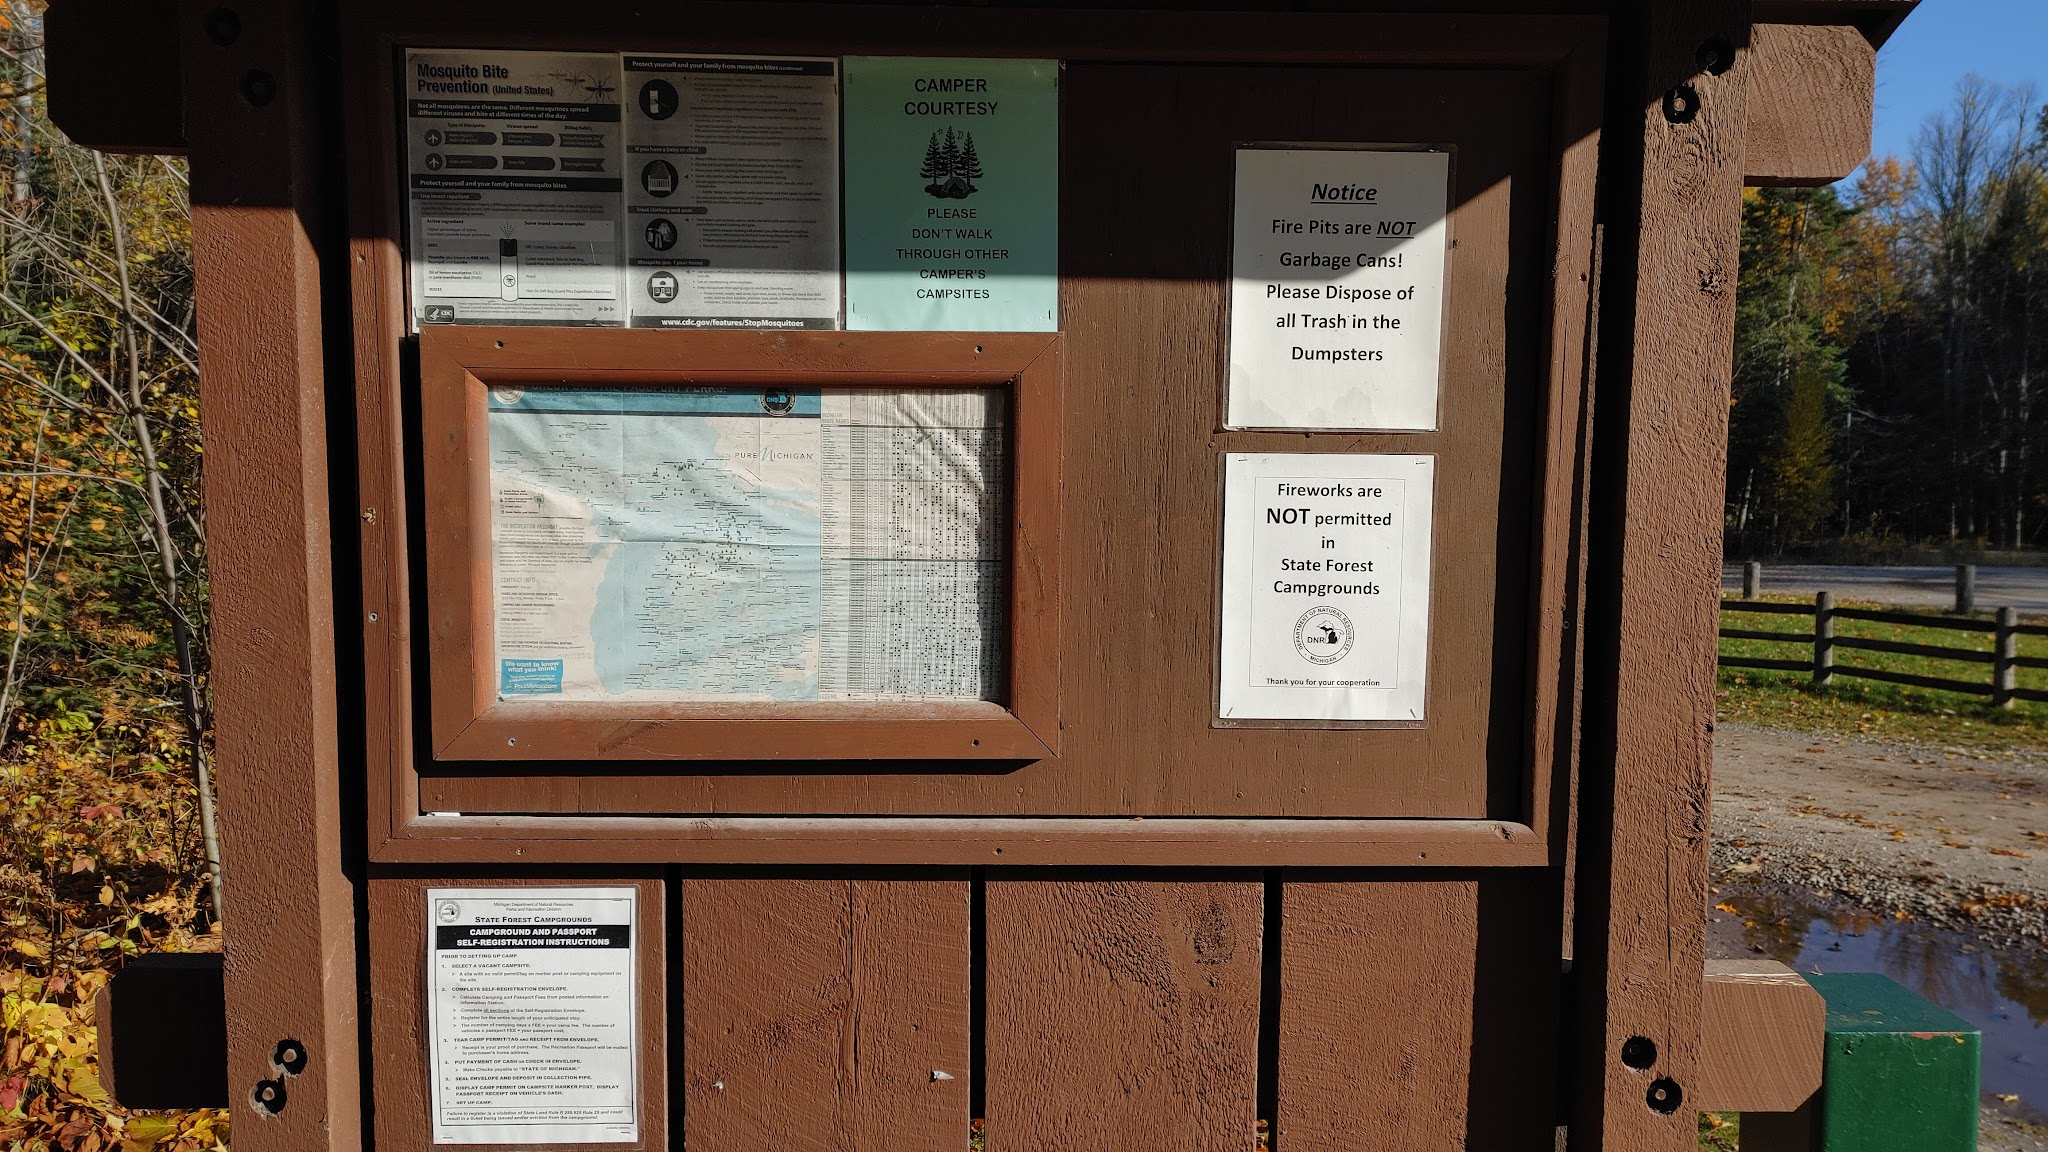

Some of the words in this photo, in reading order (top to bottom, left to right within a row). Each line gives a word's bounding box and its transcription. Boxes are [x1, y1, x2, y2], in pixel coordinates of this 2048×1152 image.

[417, 62, 478, 81] Mosquito
[482, 64, 508, 79] Bite
[417, 78, 488, 94] Prevention
[492, 84, 522, 95] (United
[523, 85, 553, 96] States)
[914, 78, 986, 92] CAMPER
[417, 102, 428, 110] Not
[535, 105, 569, 114] mosquitoes
[904, 101, 998, 115] COURTESY
[1311, 182, 1377, 201] Notice
[927, 208, 976, 218] PLEASE
[912, 228, 952, 239] DON'T
[955, 228, 992, 239] WALK
[1272, 219, 1302, 234] Fire
[1309, 219, 1339, 234] Pits
[1344, 223, 1371, 234] are
[1376, 220, 1416, 235] NOT
[895, 248, 960, 259] THROUGH
[964, 248, 1008, 259] OTHER
[1279, 251, 1350, 270] Garbage
[1356, 252, 1402, 269] Cans!
[919, 268, 986, 279] CAMPER'S
[916, 288, 989, 298] CAMPSITES
[1266, 283, 1320, 299] Please
[1326, 285, 1390, 302] Dispose
[1396, 285, 1414, 300] of
[661, 318, 804, 328] www.cdc.gov/features/StopMosquitoes
[1276, 312, 1295, 328] all
[1301, 313, 1346, 328] Trash
[1352, 314, 1366, 328] in
[1373, 314, 1400, 329] the
[1292, 346, 1382, 364] Dumpsters
[756, 446, 812, 462] MICHIGAN
[1278, 482, 1352, 497] Fireworks
[1357, 487, 1381, 497] are
[1267, 507, 1310, 524] NOT
[1315, 511, 1391, 527] permitted
[1321, 536, 1334, 548] in
[1281, 558, 1320, 571] State
[1326, 559, 1373, 572] Forest
[1273, 580, 1379, 597] Campgrounds
[1295, 614, 1309, 651] DEPARTMENT
[1317, 607, 1342, 618] NATURAL
[1341, 616, 1352, 651] RESOURCES
[1309, 655, 1337, 663] MICHIGAN
[1336, 678, 1380, 687] cooperation
[456, 938, 544, 946] SELF-REGISTRATION
